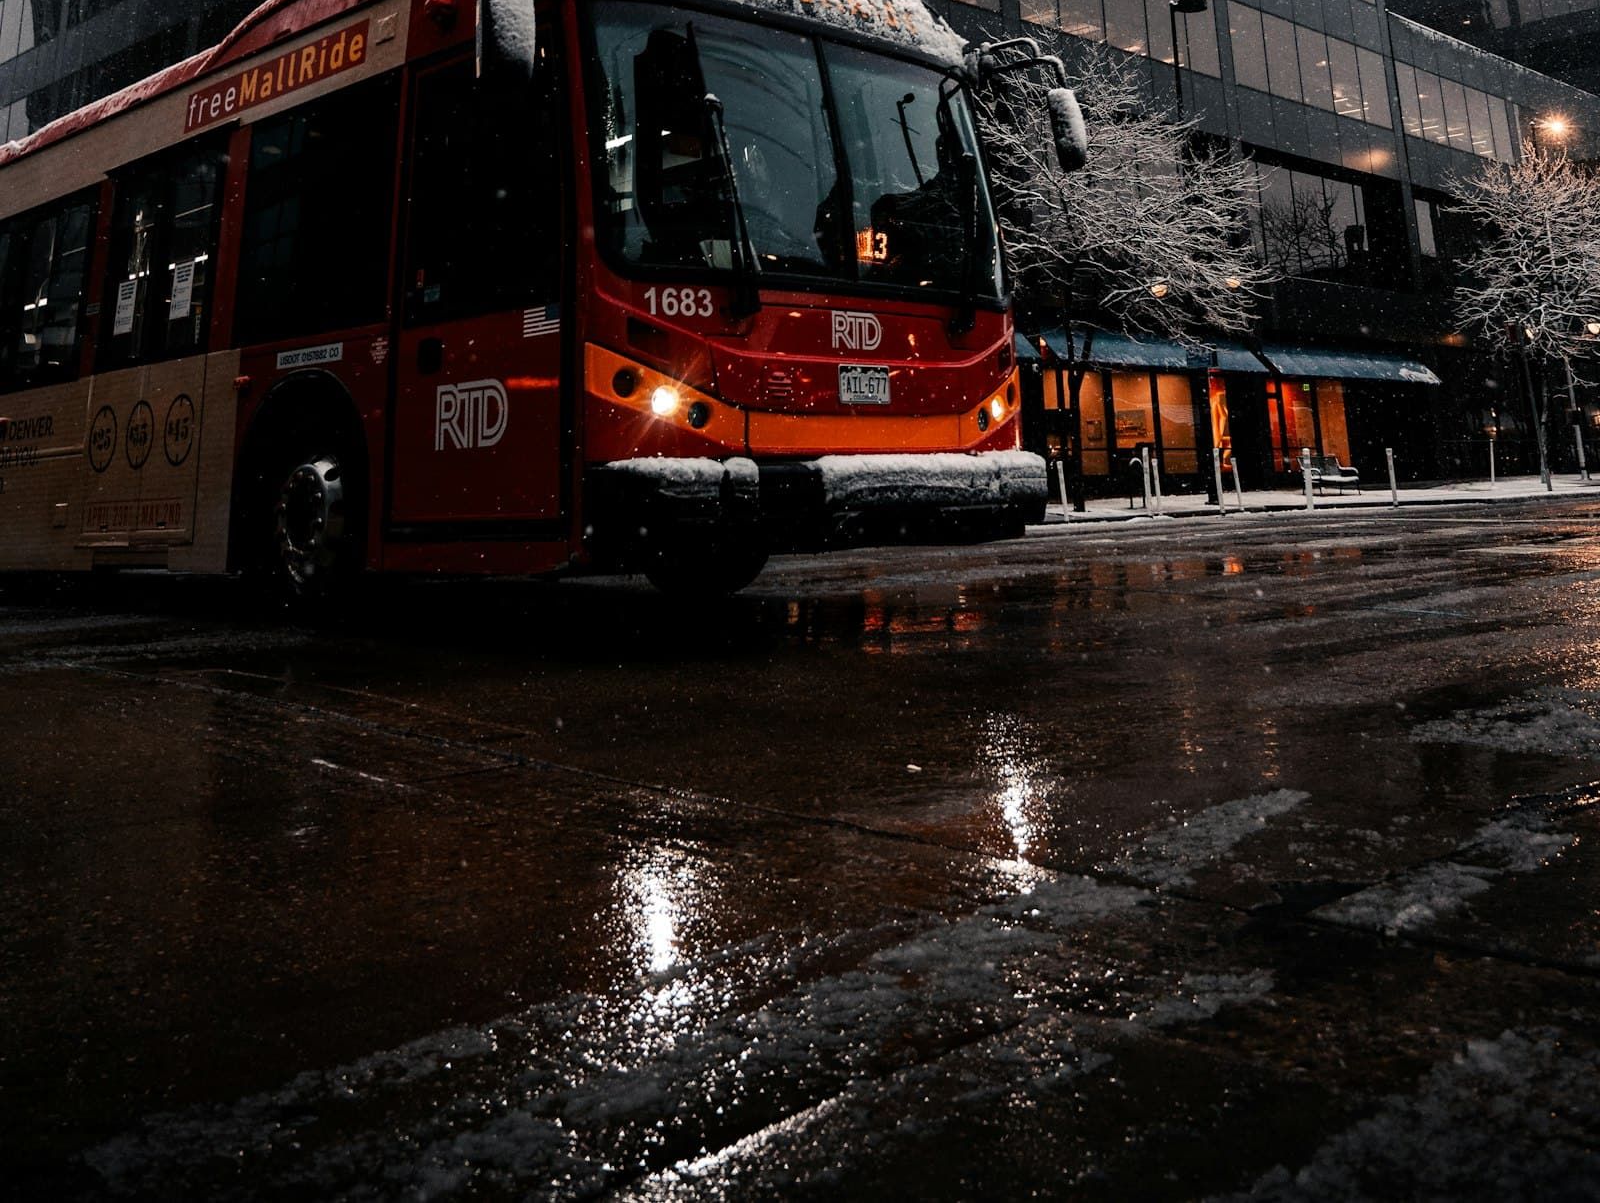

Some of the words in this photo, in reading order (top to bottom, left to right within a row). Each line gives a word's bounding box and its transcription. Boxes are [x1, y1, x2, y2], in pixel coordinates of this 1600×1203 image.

[187, 30, 364, 128] freeMallRide
[643, 286, 714, 317] 1683
[831, 310, 882, 350] RTD
[328, 346, 340, 359] CO
[434, 378, 509, 451] RTD
